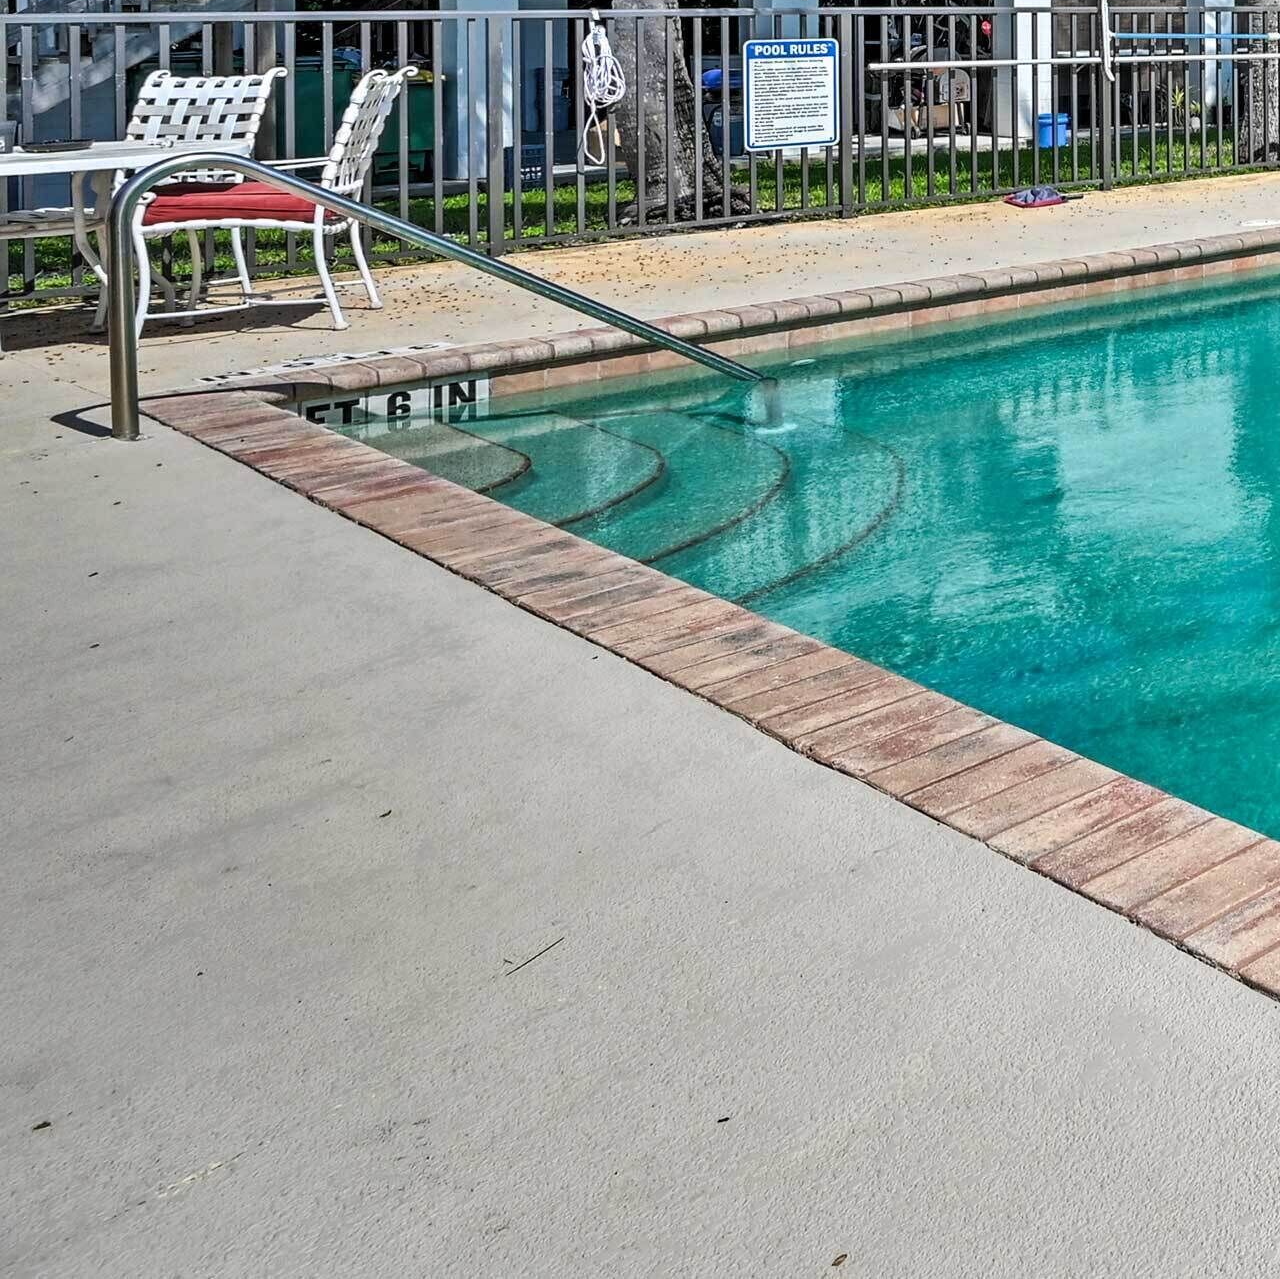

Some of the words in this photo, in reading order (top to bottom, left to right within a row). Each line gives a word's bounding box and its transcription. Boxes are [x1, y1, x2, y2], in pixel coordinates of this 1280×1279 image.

[755, 44, 787, 56] POOL
[789, 43, 828, 55] RULES
[387, 391, 411, 419] 6
[434, 379, 476, 408] IN
